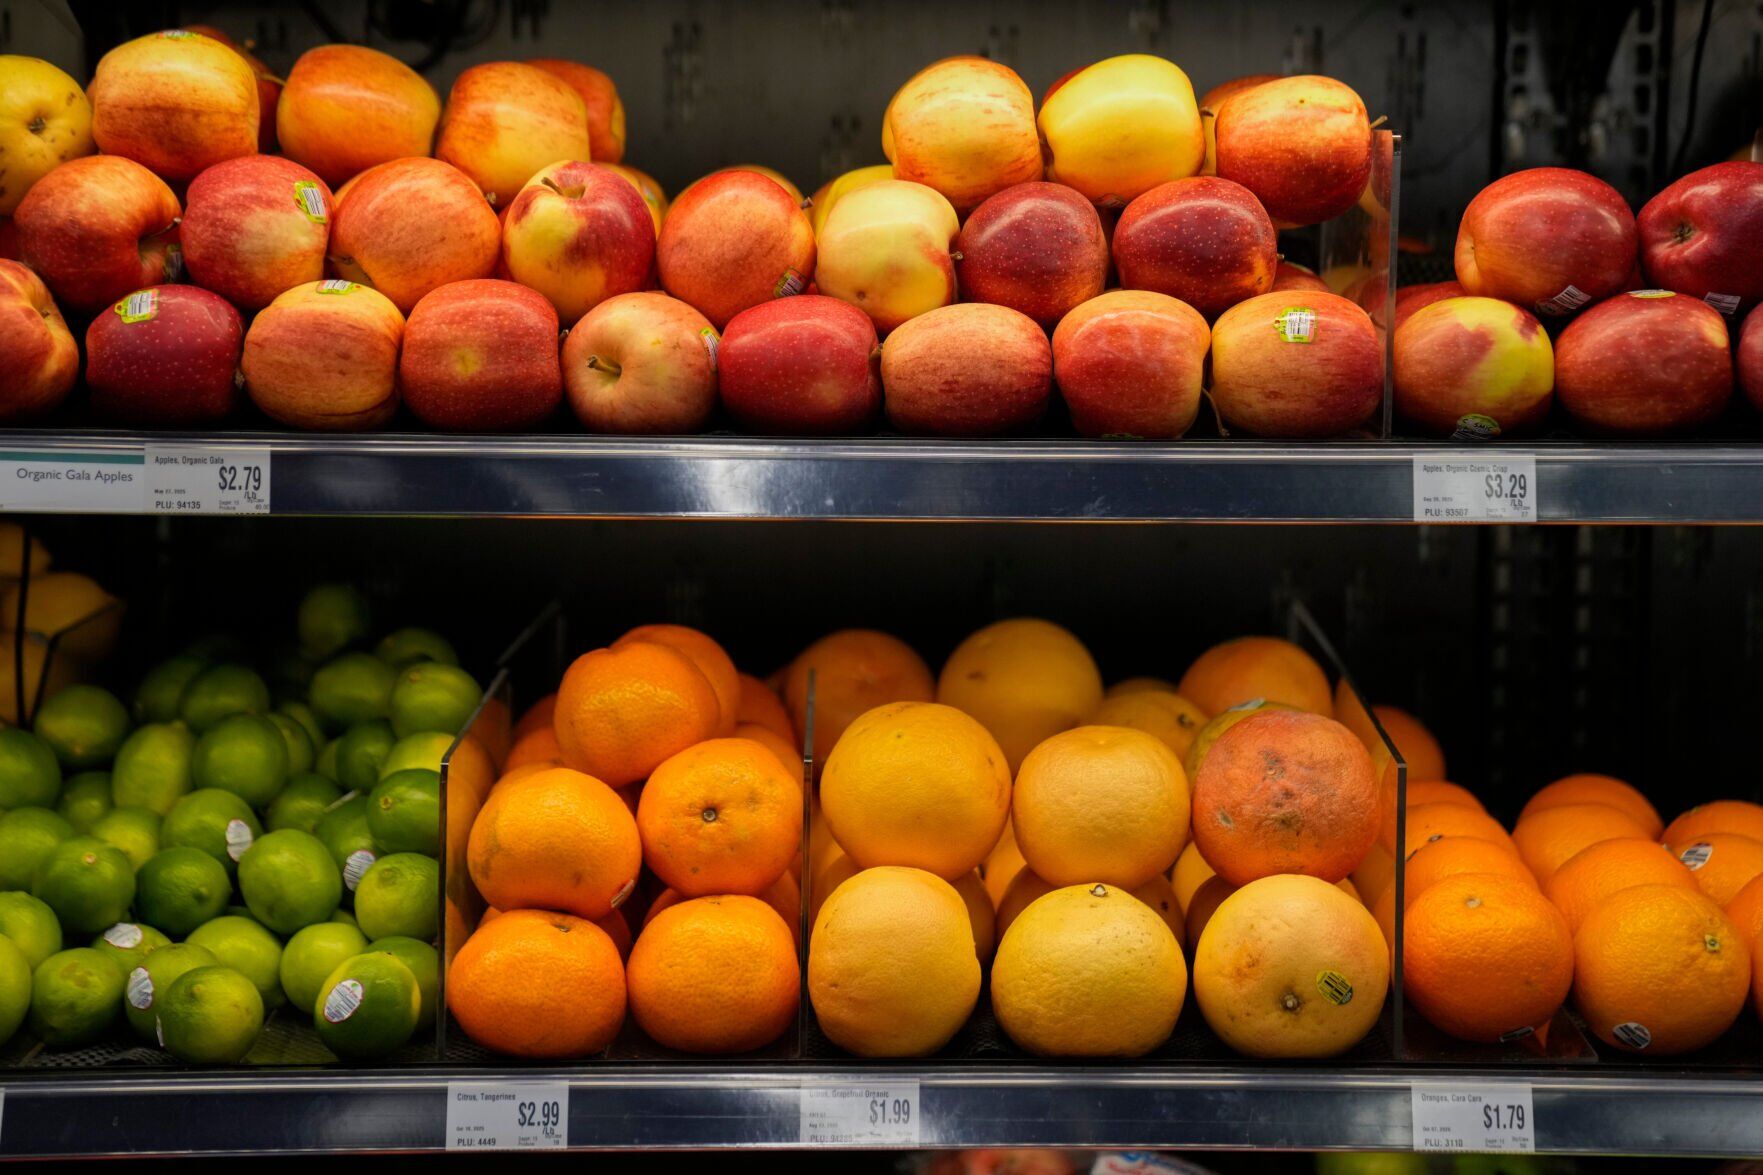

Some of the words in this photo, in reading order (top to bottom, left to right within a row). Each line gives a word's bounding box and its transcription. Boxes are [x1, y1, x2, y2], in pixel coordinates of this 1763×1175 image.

[182, 456, 207, 465] Organic
[209, 456, 224, 464] Gala
[1446, 464, 1467, 473] Organic
[1492, 464, 1508, 473] Crisp
[16, 467, 62, 482] Organic
[65, 468, 91, 481] Gala
[94, 470, 133, 484] Apples
[218, 465, 262, 492] $2.79
[1485, 473, 1527, 499] $3.29
[155, 501, 174, 509] PLU:
[176, 501, 201, 509] 94135
[1425, 508, 1443, 517] PLU:
[1445, 508, 1468, 517] 93507
[480, 1093, 516, 1102] Tangerines
[832, 1090, 863, 1099] Grapefruit
[865, 1089, 889, 1098] Organic
[1421, 1093, 1449, 1103] Oranges,
[1451, 1094, 1466, 1102] Cara
[1467, 1094, 1482, 1103] Cara
[518, 1101, 559, 1127] $2.99
[869, 1098, 910, 1126] $1.99
[1483, 1103, 1525, 1131] $1.79
[457, 1138, 475, 1147] PLU:
[477, 1138, 496, 1147] 4449
[1424, 1138, 1442, 1147] PLU:
[1445, 1138, 1463, 1147] 3110
